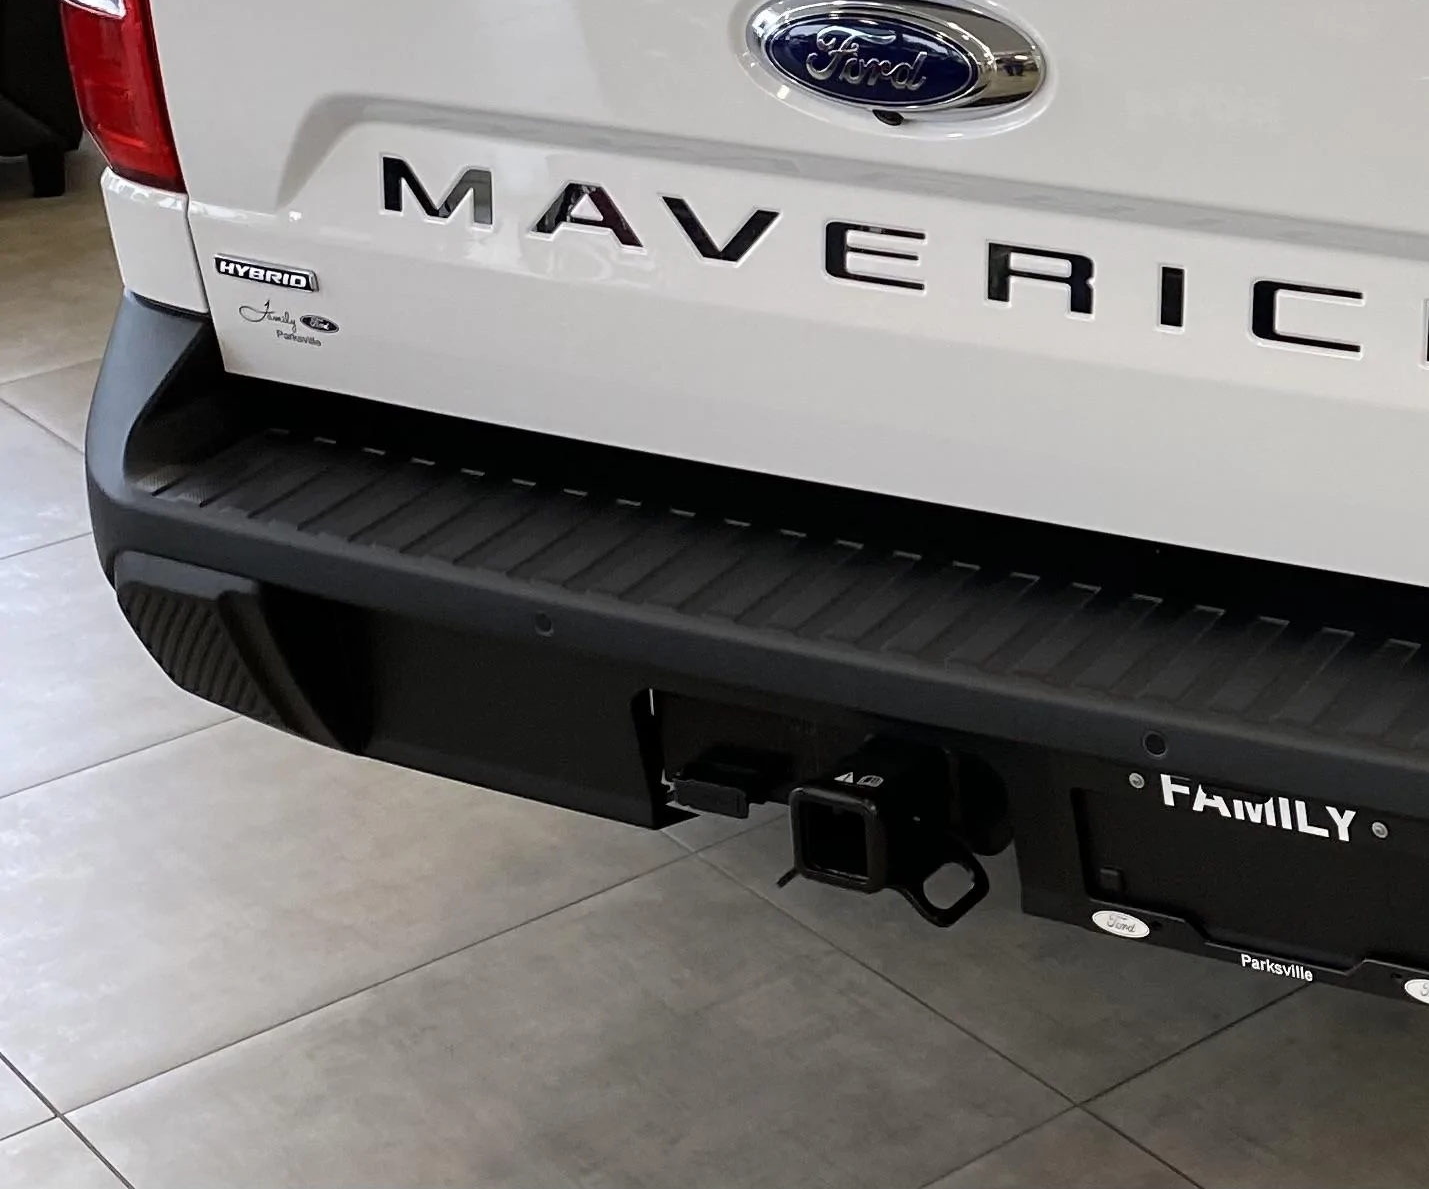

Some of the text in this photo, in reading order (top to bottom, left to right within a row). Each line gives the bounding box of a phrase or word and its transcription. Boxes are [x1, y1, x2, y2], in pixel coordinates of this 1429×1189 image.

[805, 25, 928, 91] Ford
[219, 260, 307, 288] HYBRID
[239, 299, 297, 333] Family
[276, 329, 322, 347] Parksville
[1160, 773, 1357, 843] FAMILY
[1240, 953, 1314, 983] Parksville
